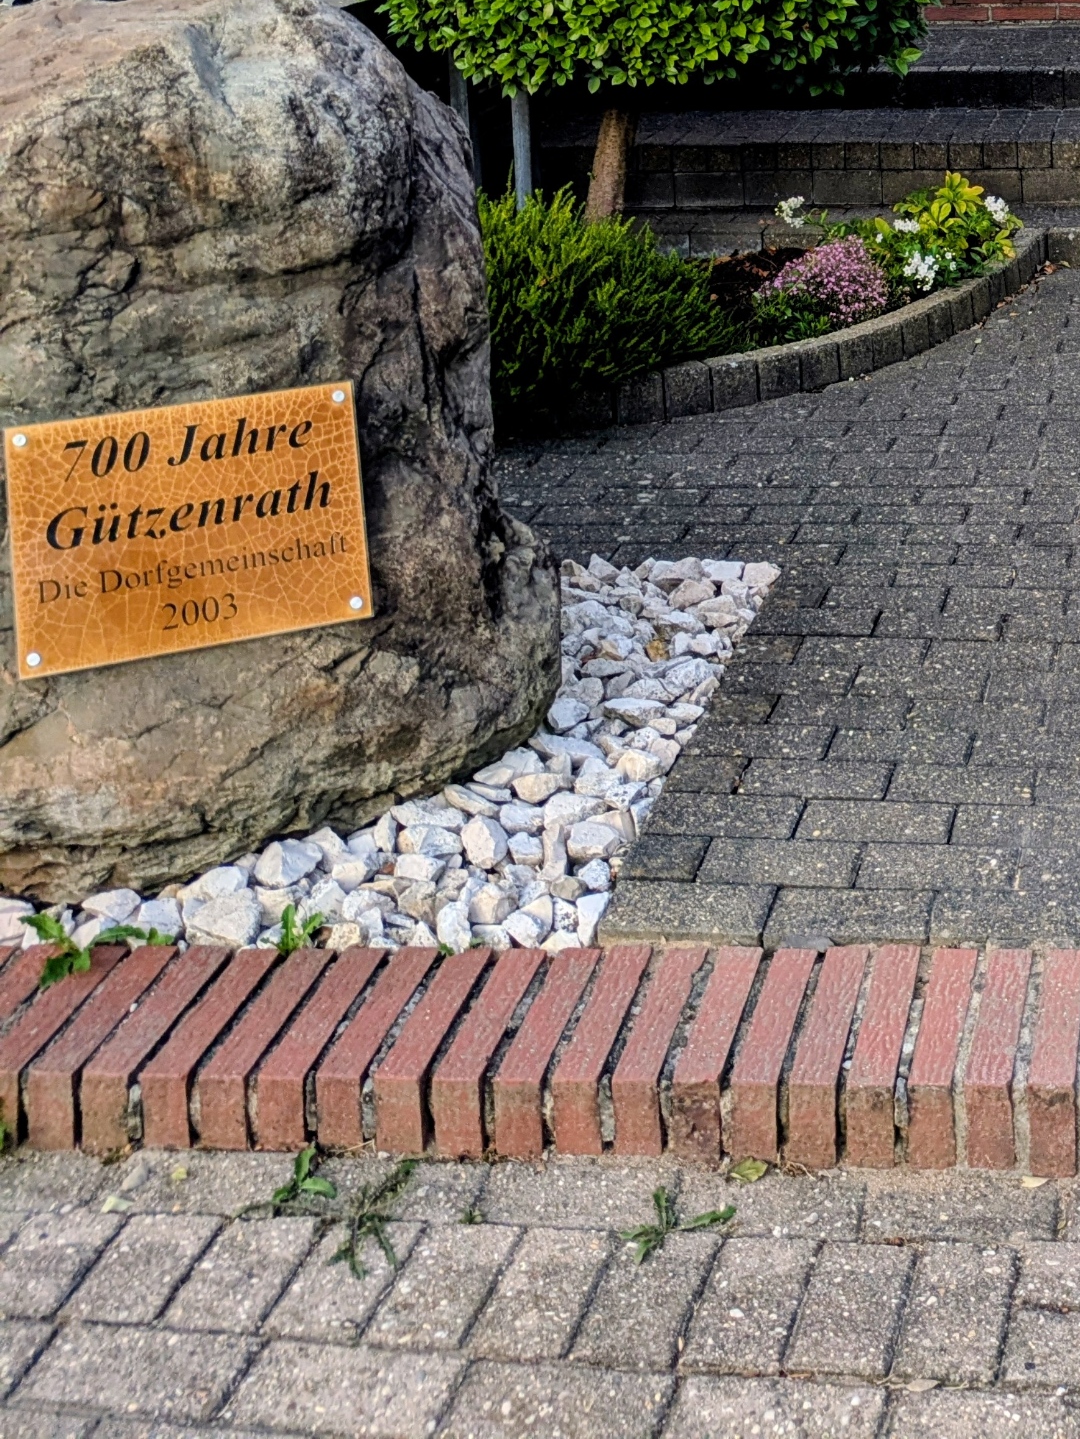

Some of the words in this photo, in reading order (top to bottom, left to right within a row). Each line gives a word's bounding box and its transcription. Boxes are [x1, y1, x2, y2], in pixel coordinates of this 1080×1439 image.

[63, 431, 151, 482] 700
[167, 417, 313, 467] Jahre
[46, 471, 332, 551] Gützenrath
[38, 575, 89, 604] Die
[100, 531, 348, 594] Dorfgemeinschaft
[162, 592, 239, 631] 2003
